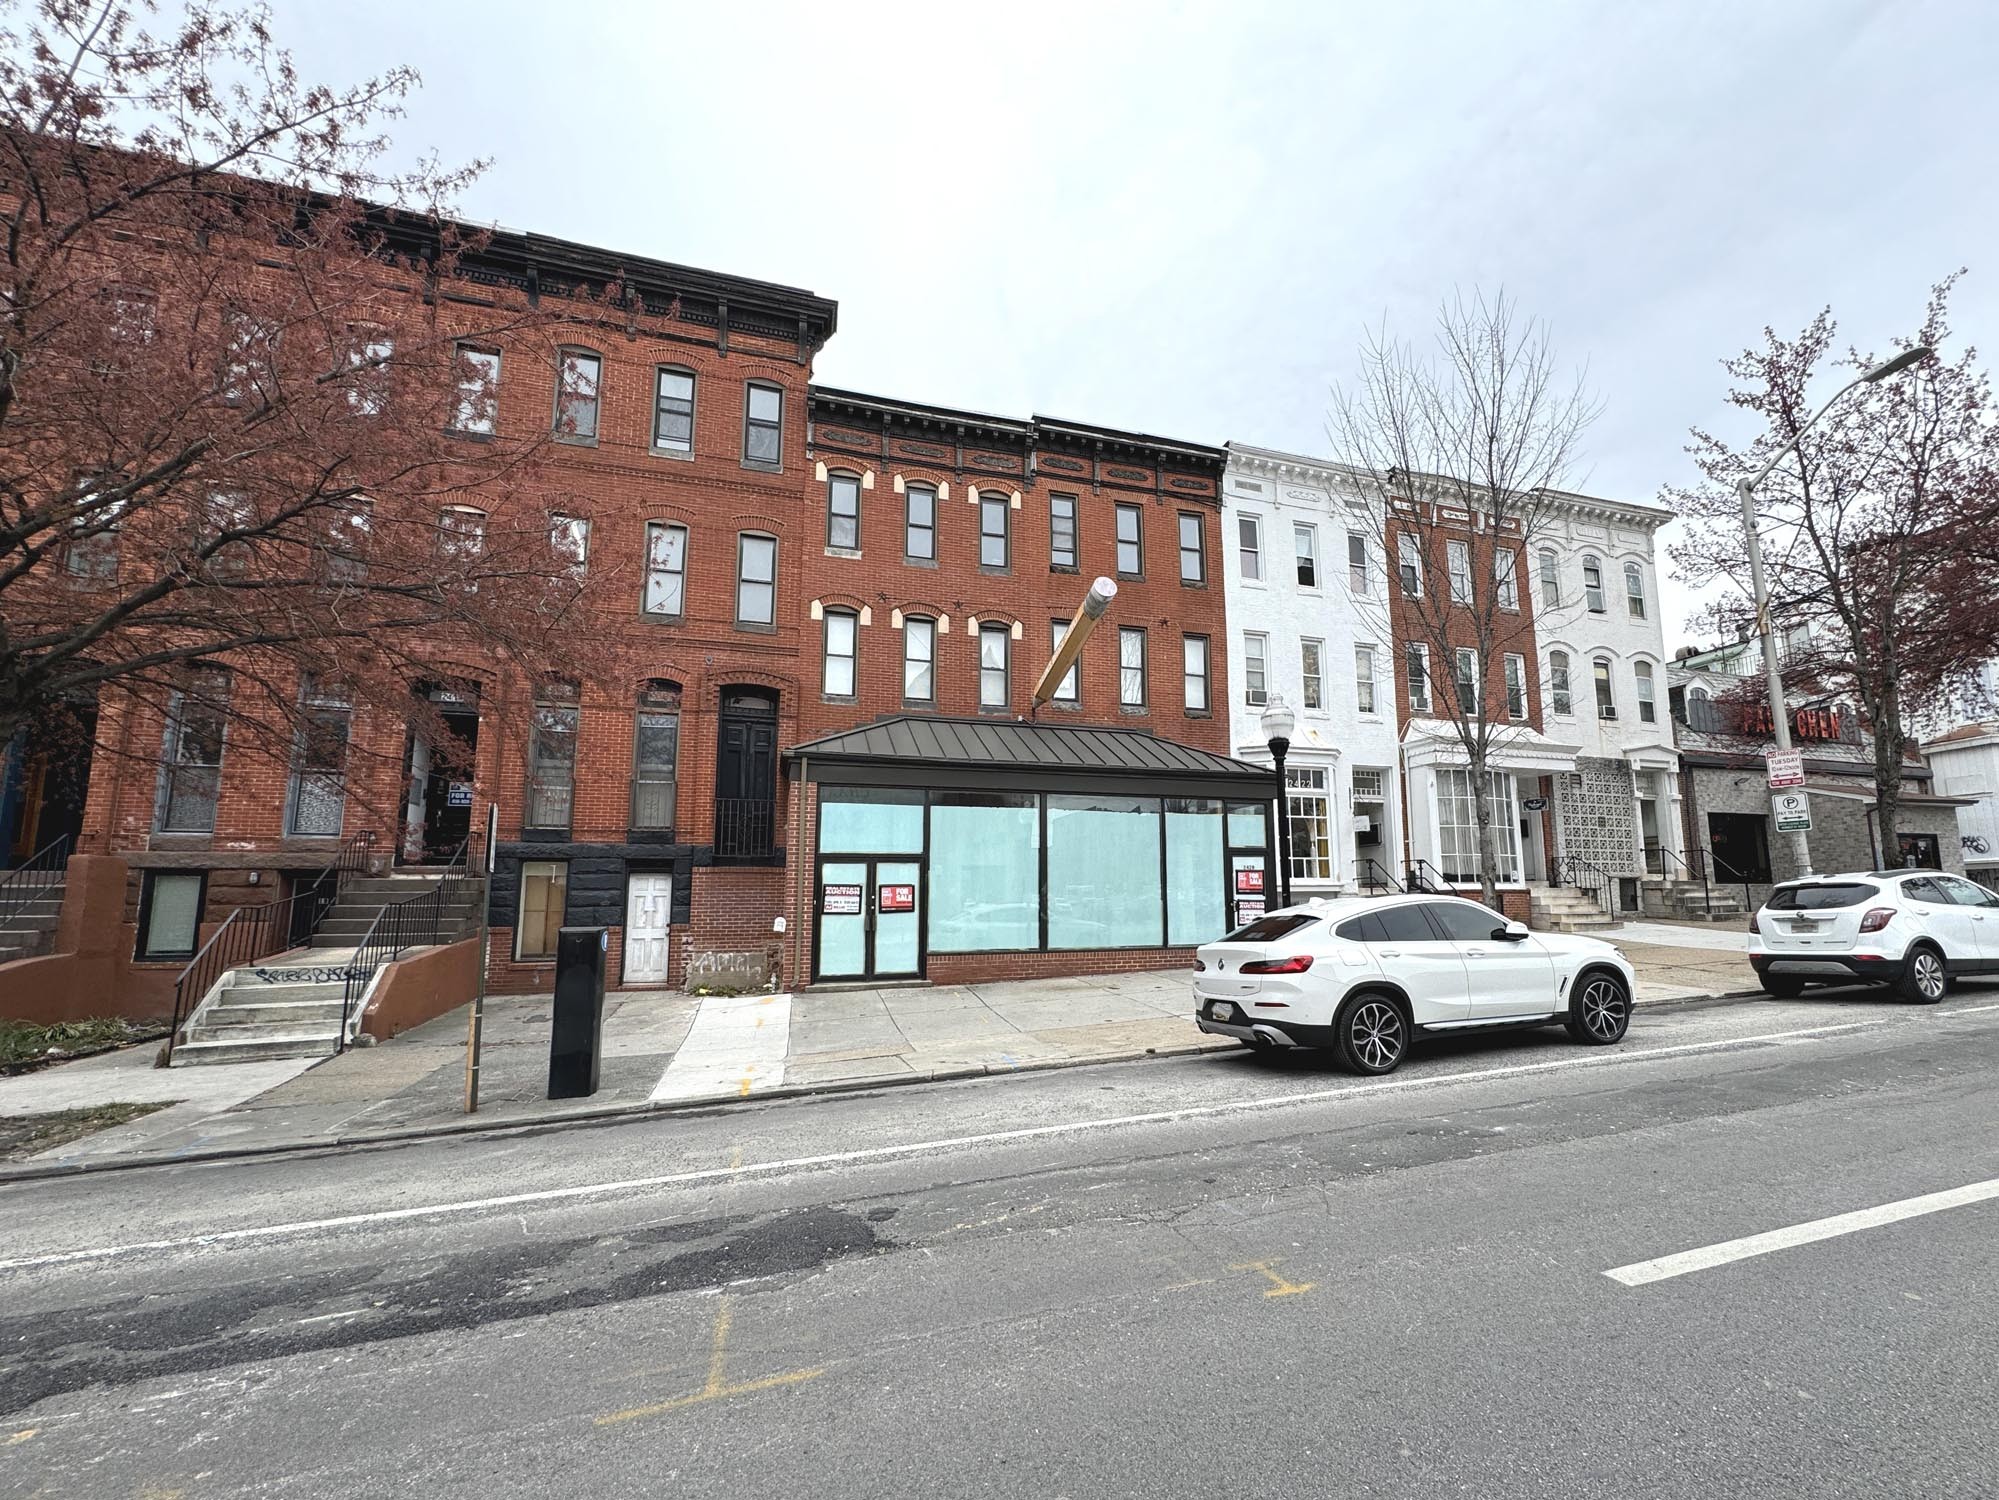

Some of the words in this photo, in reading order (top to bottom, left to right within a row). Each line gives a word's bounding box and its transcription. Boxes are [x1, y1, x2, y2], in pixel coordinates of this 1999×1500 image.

[1796, 709, 1840, 739] CHEN
[1771, 757, 1799, 765] TUESDAY
[1288, 779, 1311, 788] 2422
